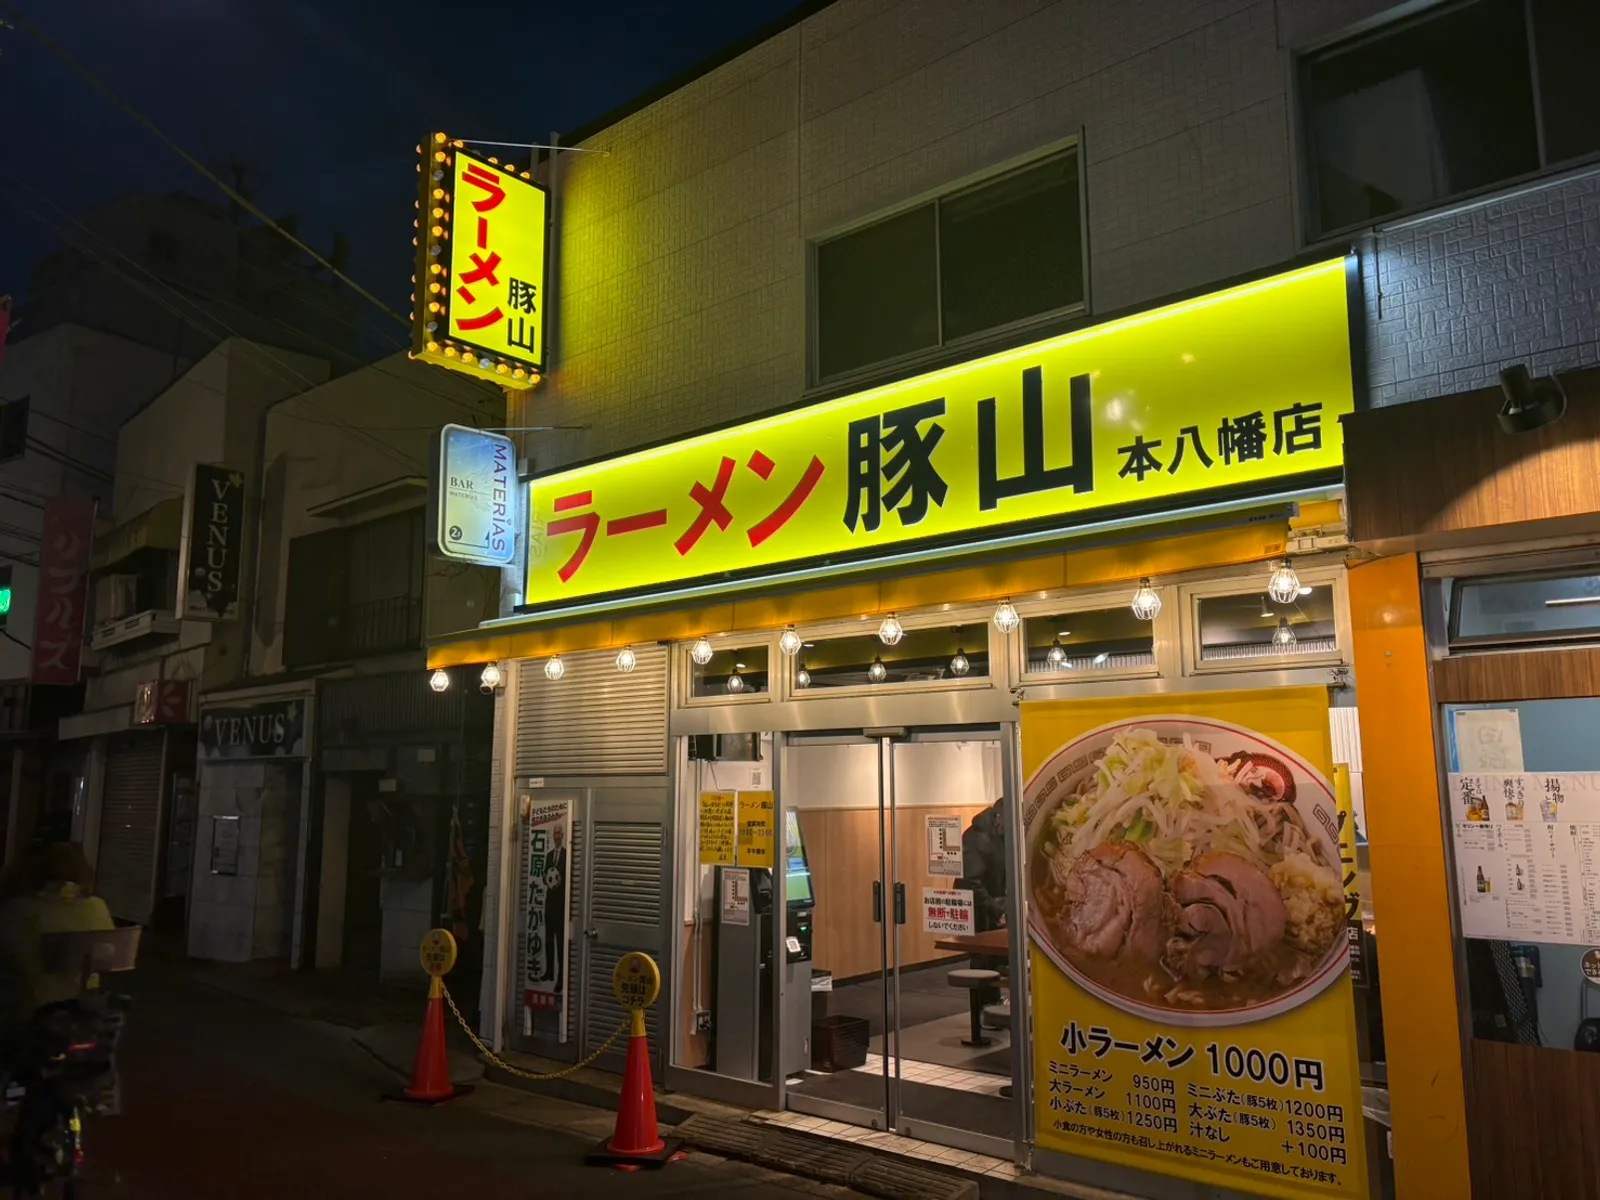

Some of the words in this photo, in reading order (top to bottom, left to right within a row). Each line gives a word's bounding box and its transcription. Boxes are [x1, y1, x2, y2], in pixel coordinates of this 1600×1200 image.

[456, 162, 507, 331] ラーメン
[507, 276, 538, 354] 豚山
[450, 477, 474, 490] BAR
[546, 448, 825, 584] ラーメン
[843, 366, 1095, 533] 豚山
[1117, 402, 1322, 482] 本八幡店
[205, 478, 230, 593] VENUS
[214, 712, 285, 747] VENUS
[1060, 1021, 1195, 1069] 小ラーメン
[1206, 1043, 1324, 1091] 1000円
[1049, 1060, 1113, 1082] ミニラーメン
[1132, 1074, 1175, 1095] 950円
[1049, 1078, 1106, 1099] 大ラーメン
[1126, 1092, 1176, 1114] 1100円
[1285, 1099, 1344, 1123] 1200円
[1127, 1111, 1178, 1133] 1250円
[1189, 1121, 1231, 1143] 汁なし
[1287, 1119, 1345, 1144] 1350円
[1053, 1119, 1342, 1186] 小食の方や女性の方も召し上がれるミニラーメンもご用意しております。
